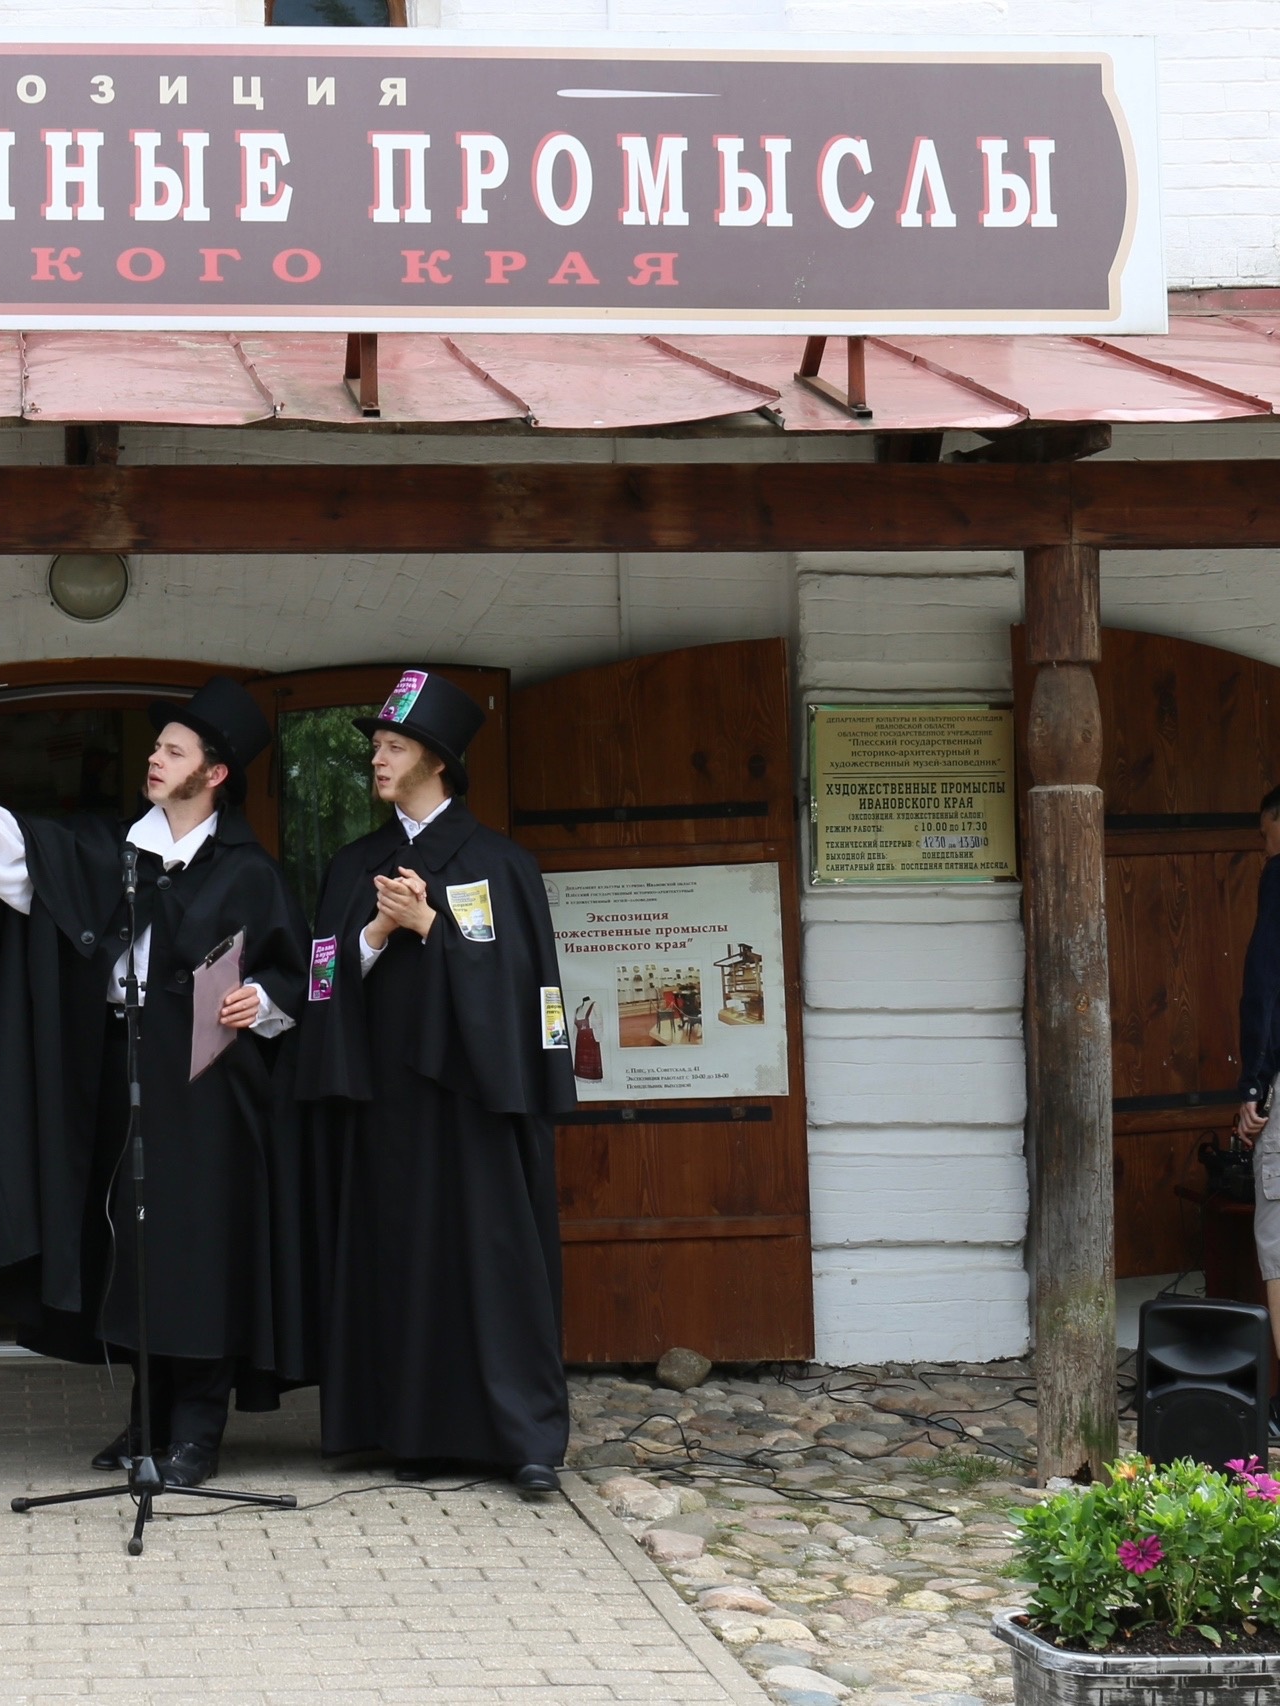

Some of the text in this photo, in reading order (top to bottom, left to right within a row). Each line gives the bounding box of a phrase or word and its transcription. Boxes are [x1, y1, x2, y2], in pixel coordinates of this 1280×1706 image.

[367, 130, 1057, 230] ПРОМЫСЛЫ
[402, 249, 680, 287] КРАЯ
[826, 716, 875, 724] ДЕПАРТАМЕНТ
[900, 737, 982, 747] государственный
[851, 748, 971, 758] историко-архитектурный
[829, 759, 910, 769] художественный
[826, 782, 1005, 796] ХУДОЖЕСТВЕННЫЕ ПРОМЫСЛЫ
[859, 797, 974, 810] ИВАНОВСКОГО КРАЯ
[897, 812, 958, 820] ХУДОЖЕСТВЕННЫЙ
[853, 825, 884, 833] РАБОТЫ:
[921, 822, 948, 832] 10.00
[949, 824, 959, 832] до
[961, 821, 988, 831] 17.30
[826, 840, 878, 848] ТЕХНИЧЕСКИЙ
[879, 840, 914, 848] ПЕРЕРЫВ:
[826, 852, 865, 860] ВЫХОДНОЙ
[826, 863, 875, 871] САНИТАРНЫЙ
[586, 912, 669, 923] Экспозиция
[553, 924, 728, 940] дожественные промыслы
[564, 942, 651, 954] Ивановского
